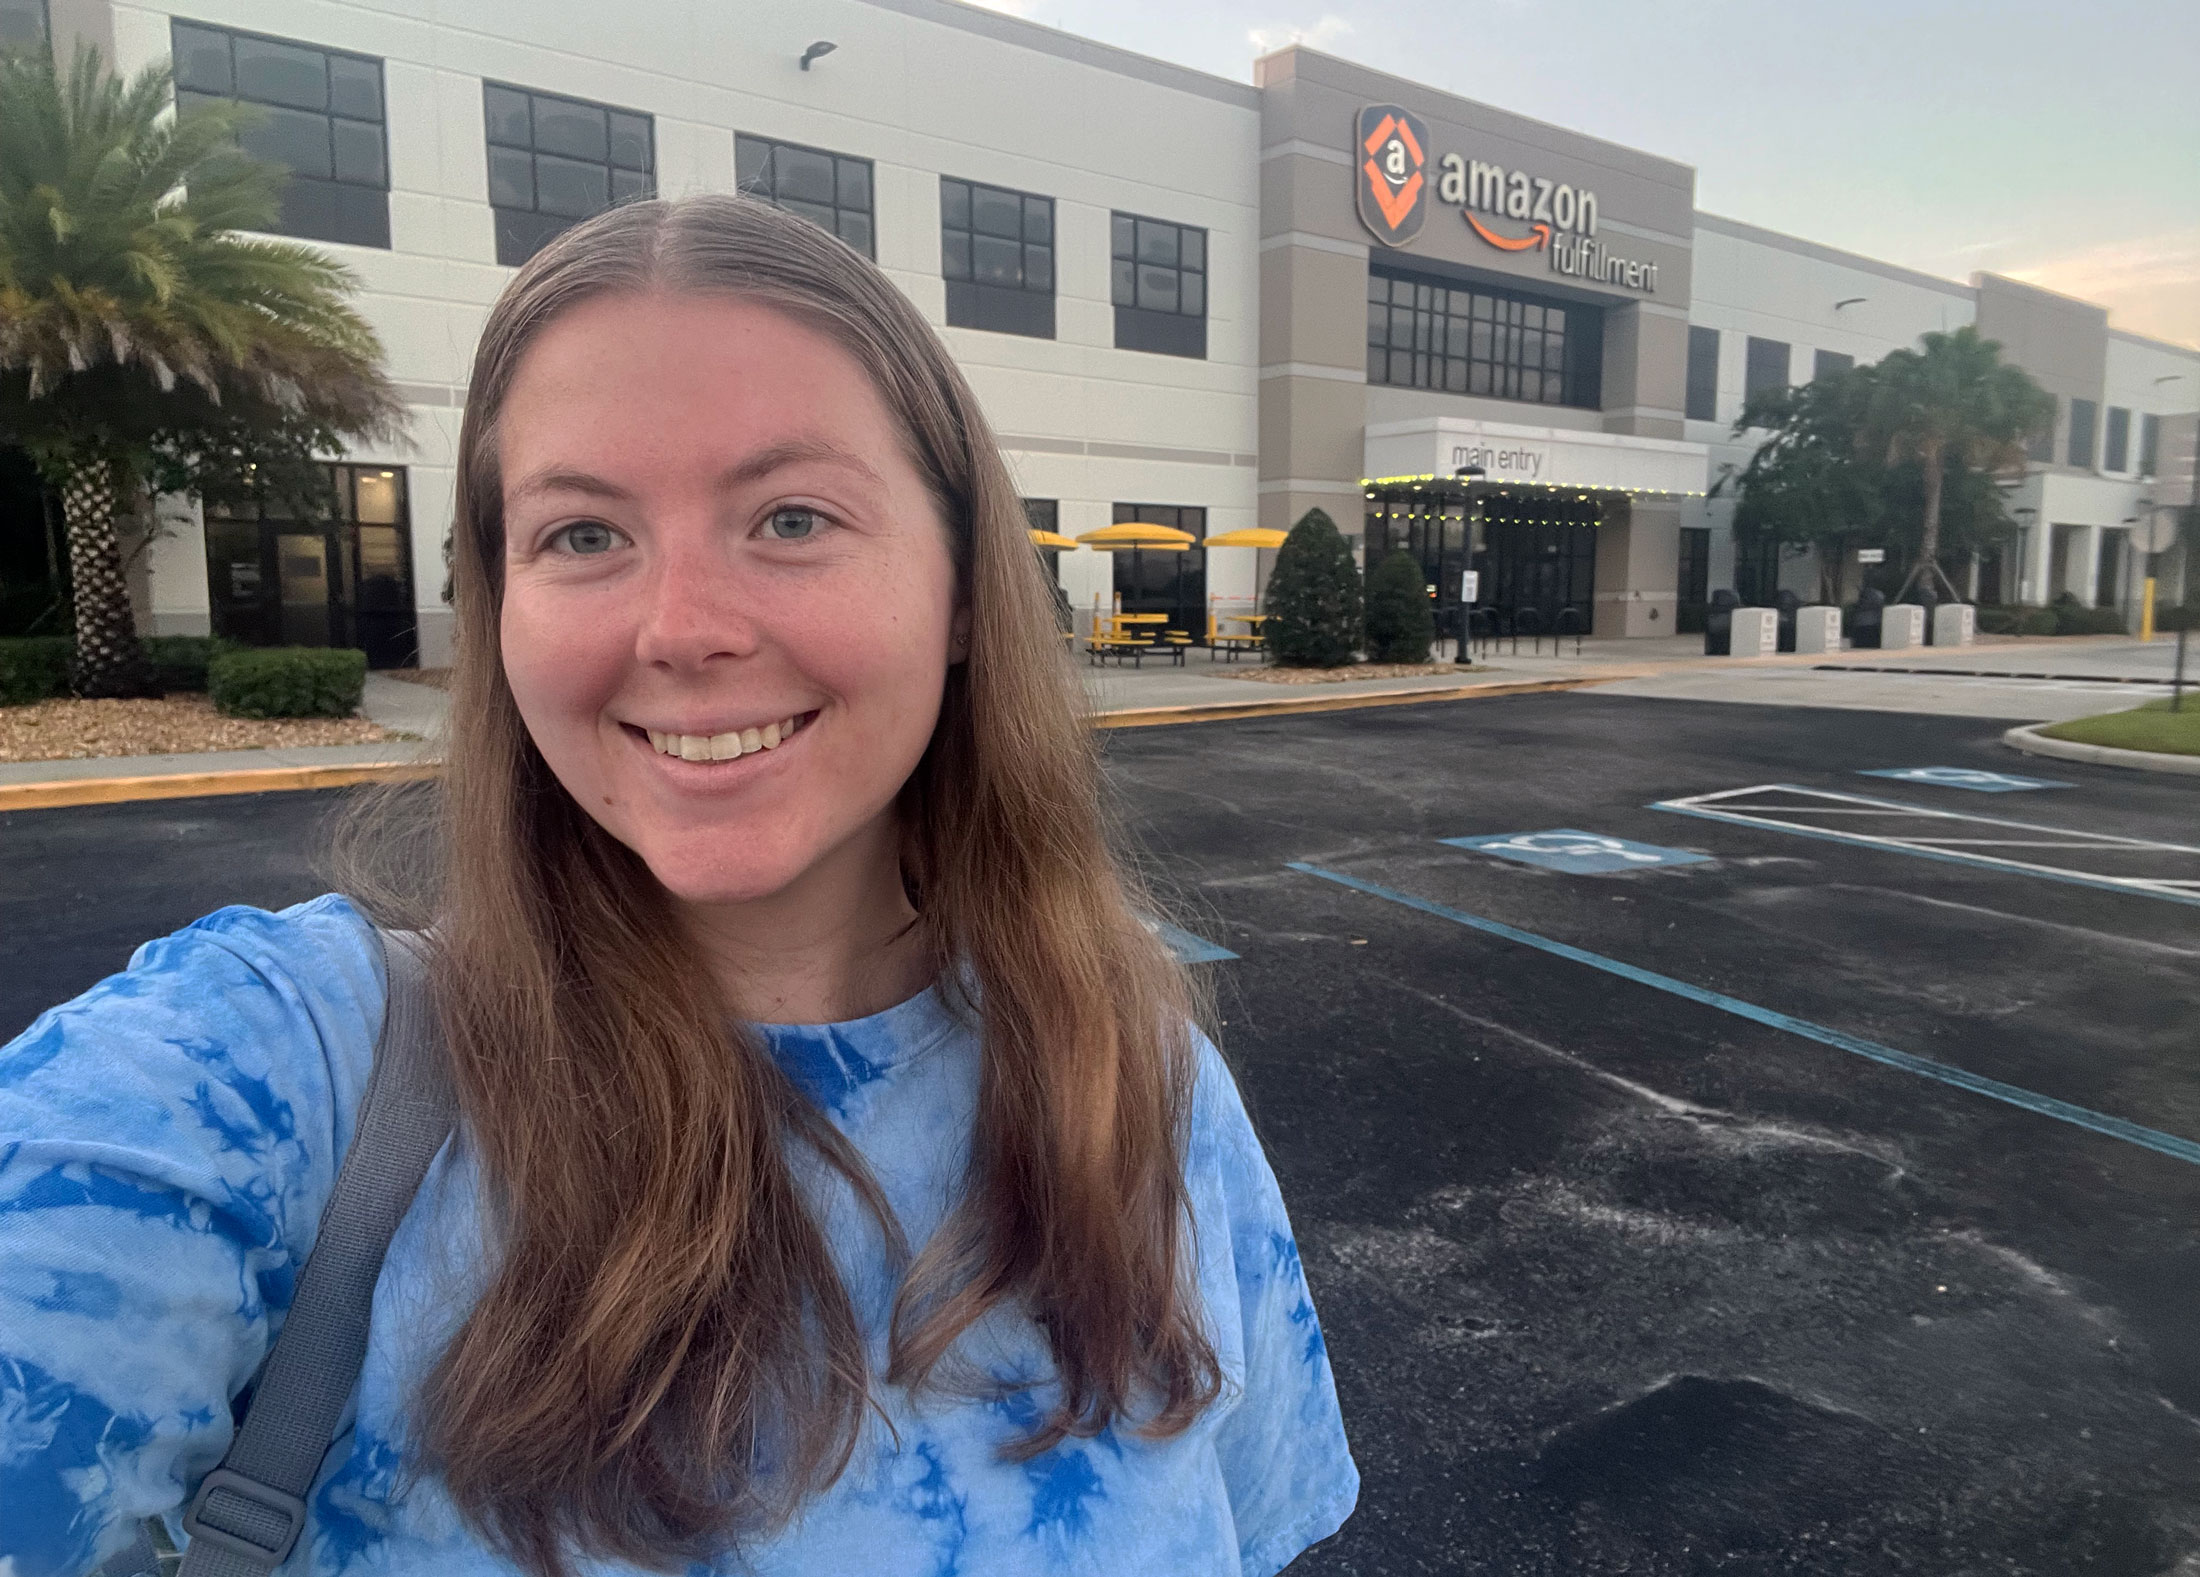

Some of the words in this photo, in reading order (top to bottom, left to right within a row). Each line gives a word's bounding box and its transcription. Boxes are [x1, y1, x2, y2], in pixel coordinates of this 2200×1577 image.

[1386, 139, 1405, 174] a
[1439, 152, 1598, 237] amazon
[1551, 232, 1659, 292] fulfillment
[1452, 441, 1494, 468] main
[1498, 447, 1542, 477] entry
